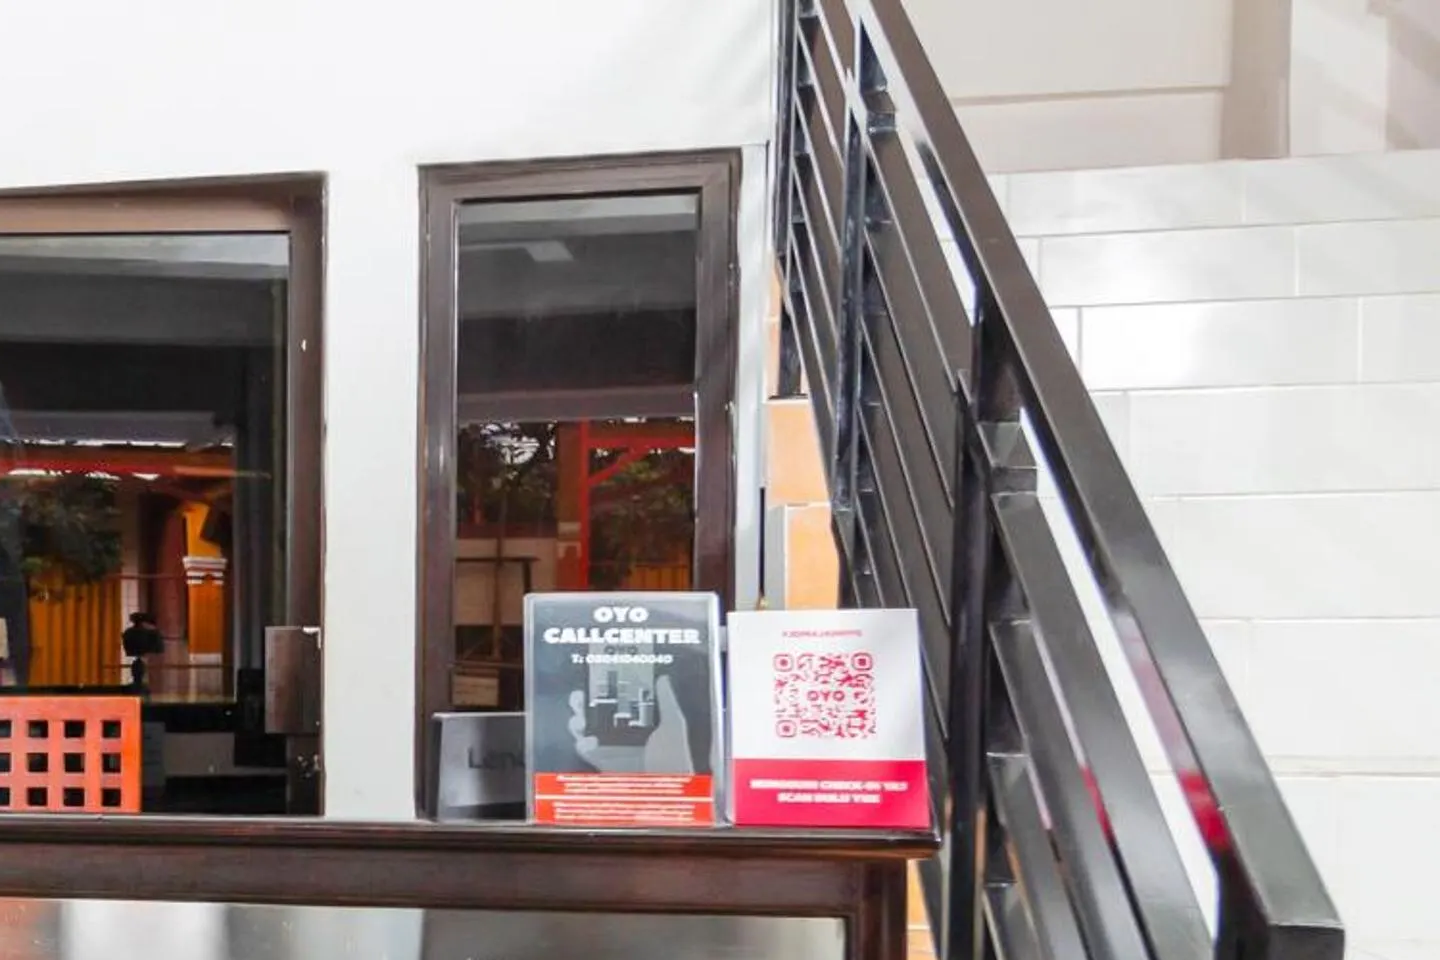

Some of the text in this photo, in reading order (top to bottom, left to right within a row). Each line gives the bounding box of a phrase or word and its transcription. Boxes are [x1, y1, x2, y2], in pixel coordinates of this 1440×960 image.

[593, 606, 649, 623] OYO
[543, 627, 701, 644] CALLCENTER
[807, 690, 845, 702] OYO
[468, 746, 525, 769] Len
